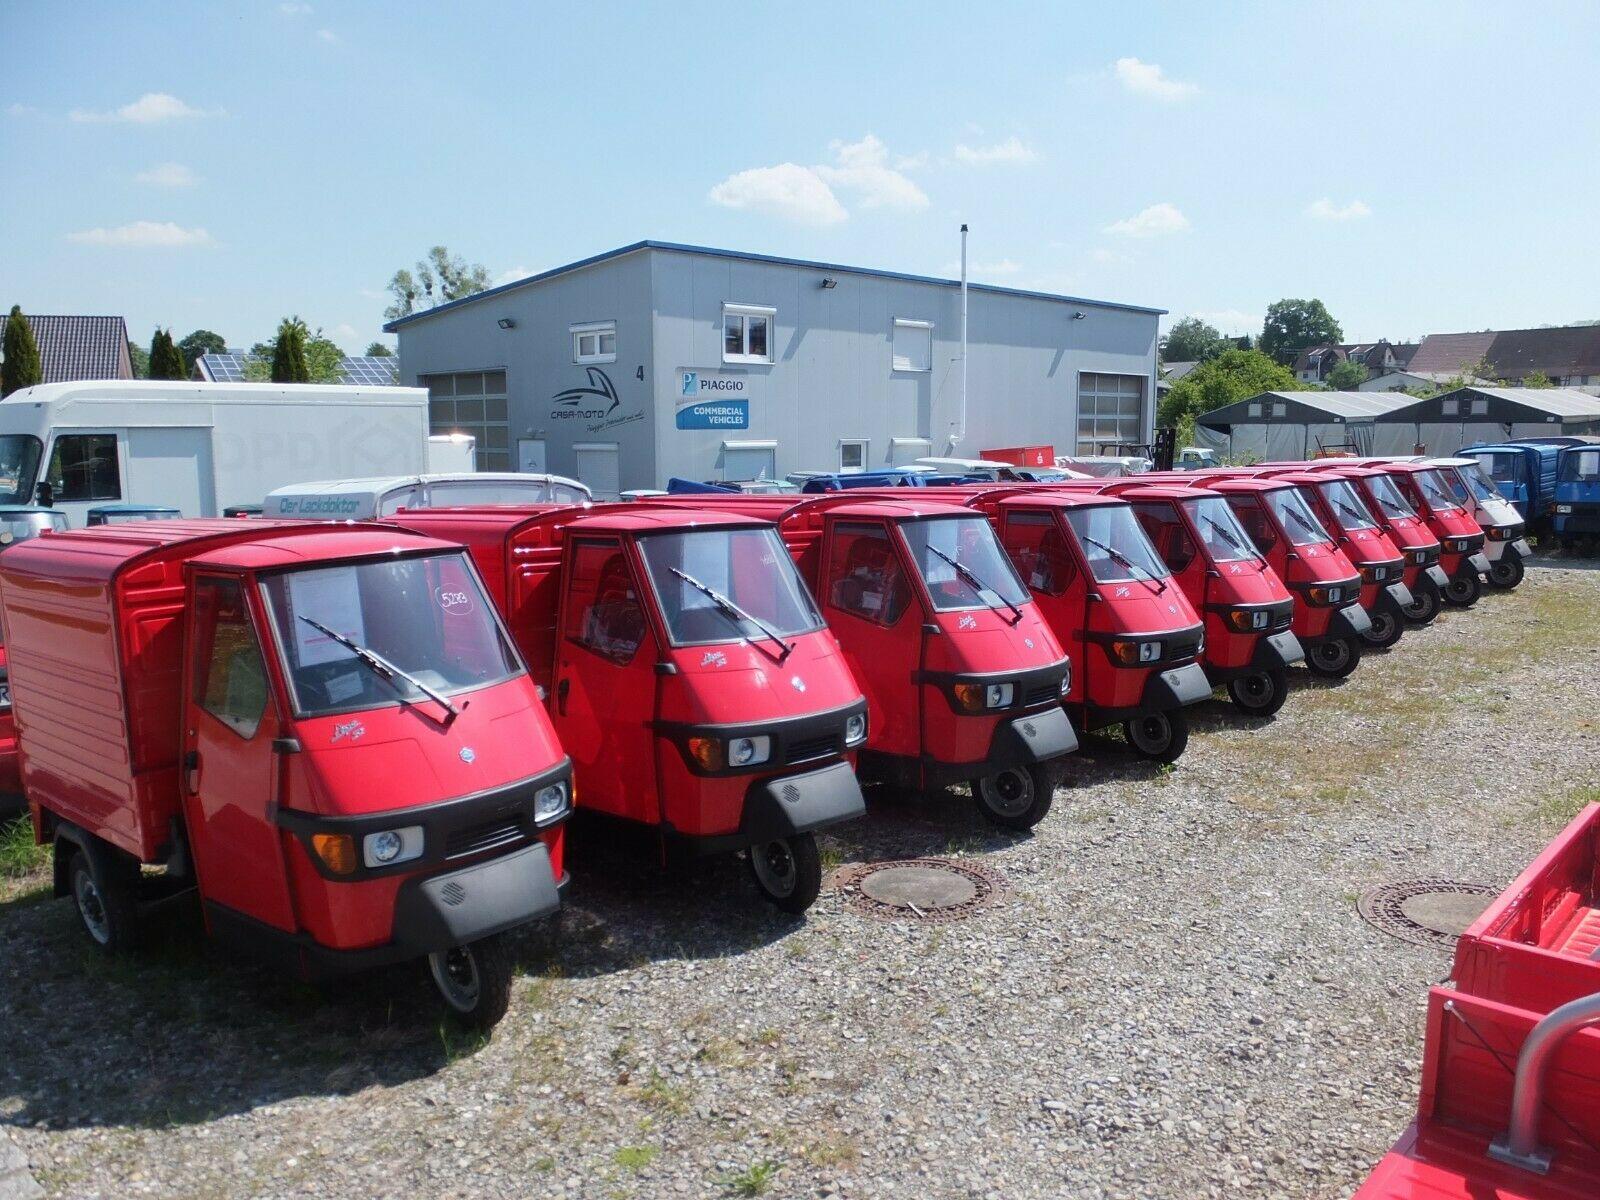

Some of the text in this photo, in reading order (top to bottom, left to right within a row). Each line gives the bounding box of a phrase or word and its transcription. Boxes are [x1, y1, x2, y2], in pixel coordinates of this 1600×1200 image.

[636, 365, 644, 381] 4
[700, 380, 744, 391] PIAGGIO
[551, 410, 604, 420] CASA-MOTO
[693, 407, 744, 415] COMMERCIAL
[708, 416, 744, 425] VEHICLES
[280, 495, 360, 513] Der Lackdoktor
